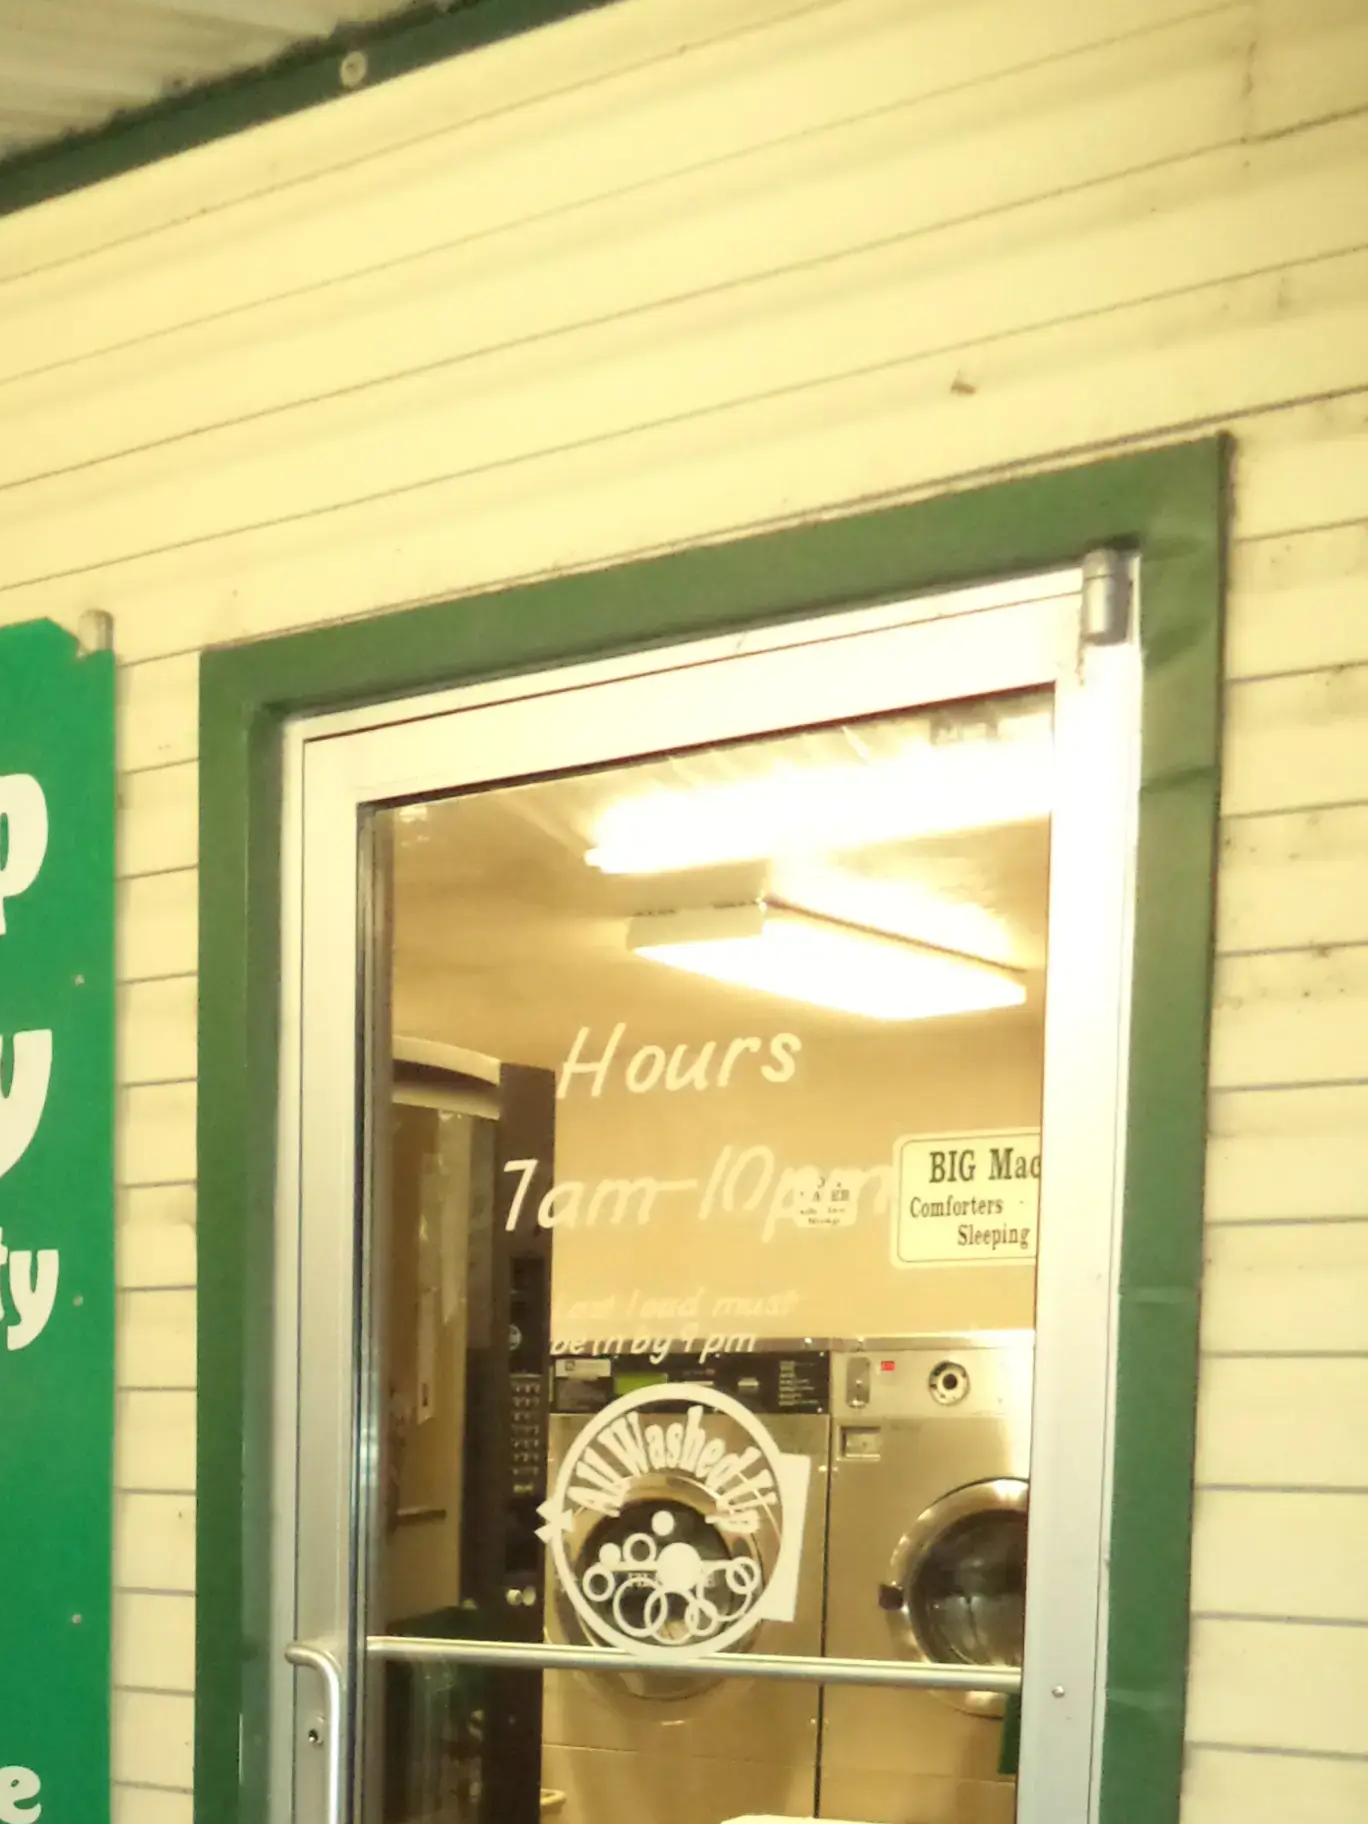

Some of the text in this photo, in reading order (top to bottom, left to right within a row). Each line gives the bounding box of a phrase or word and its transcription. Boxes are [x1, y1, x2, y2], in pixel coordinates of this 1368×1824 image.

[555, 1022, 802, 1100] Hours
[928, 1149, 976, 1184] BIG
[909, 1195, 1004, 1218] Comforters
[957, 1223, 1031, 1250] Sleeping
